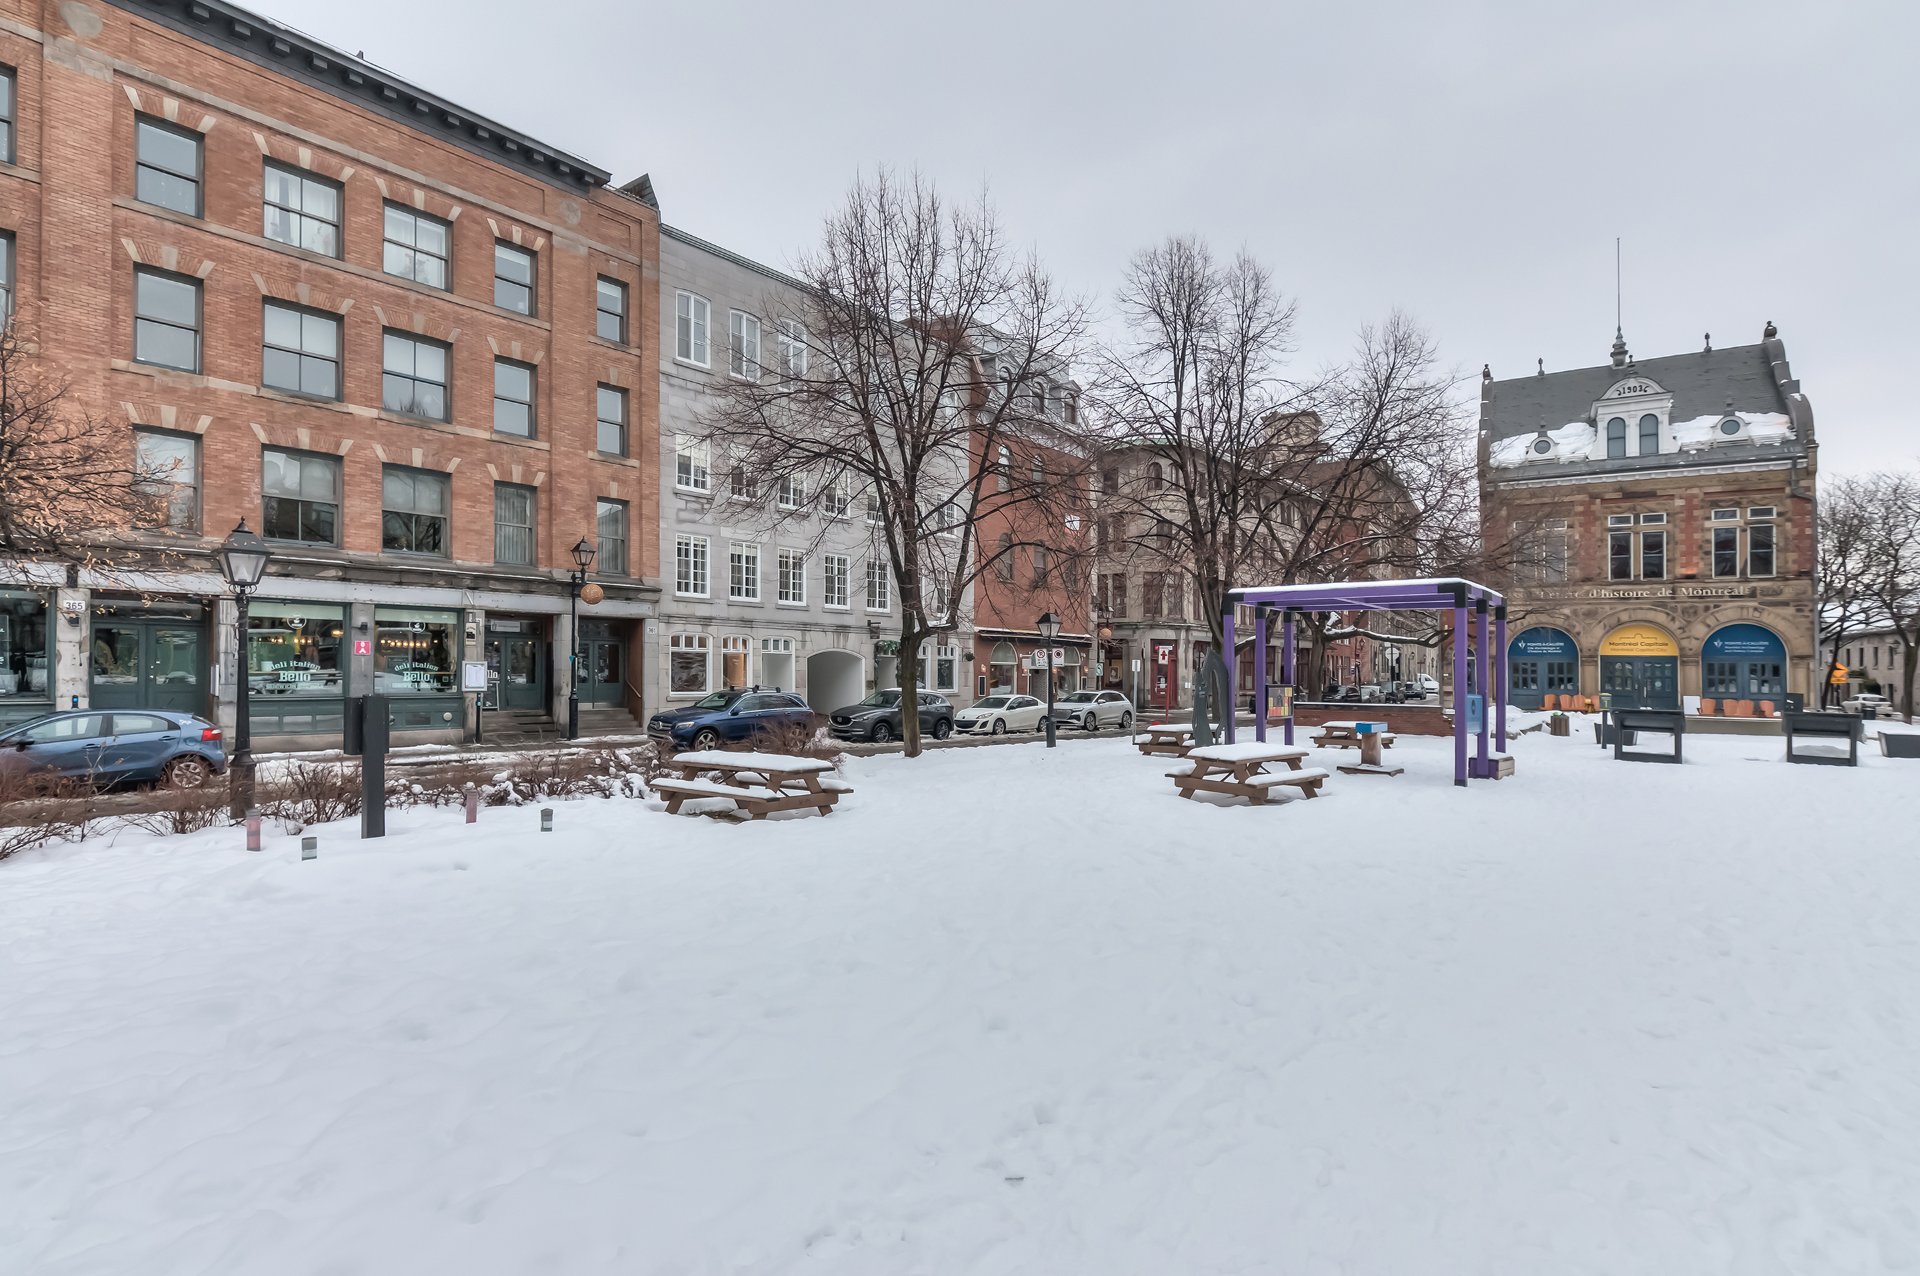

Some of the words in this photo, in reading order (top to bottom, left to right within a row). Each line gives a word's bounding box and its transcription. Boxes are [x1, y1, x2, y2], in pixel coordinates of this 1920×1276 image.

[1622, 385, 1643, 395] 1903
[1657, 587, 1673, 597] de
[65, 601, 83, 610] 365
[279, 670, 311, 682] Bello
[402, 671, 430, 682] Bello
